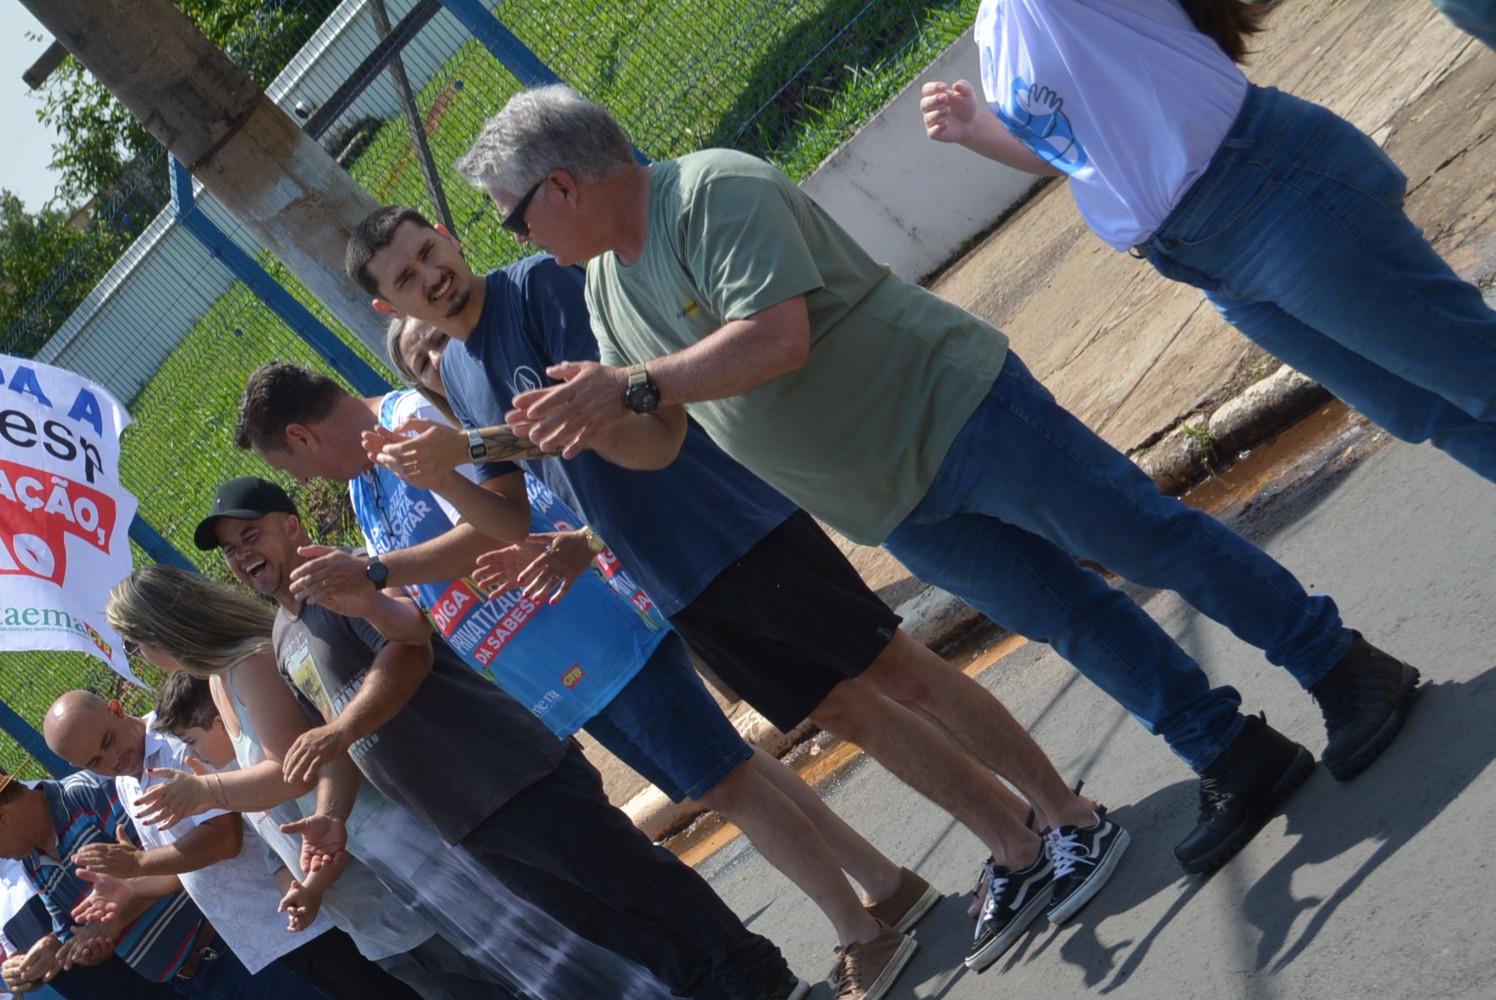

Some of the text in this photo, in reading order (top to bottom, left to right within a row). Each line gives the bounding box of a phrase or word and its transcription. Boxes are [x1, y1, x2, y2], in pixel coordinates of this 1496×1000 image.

[68, 387, 102, 438] A
[434, 590, 471, 631] DIGA
[475, 599, 541, 664] DA SABES
